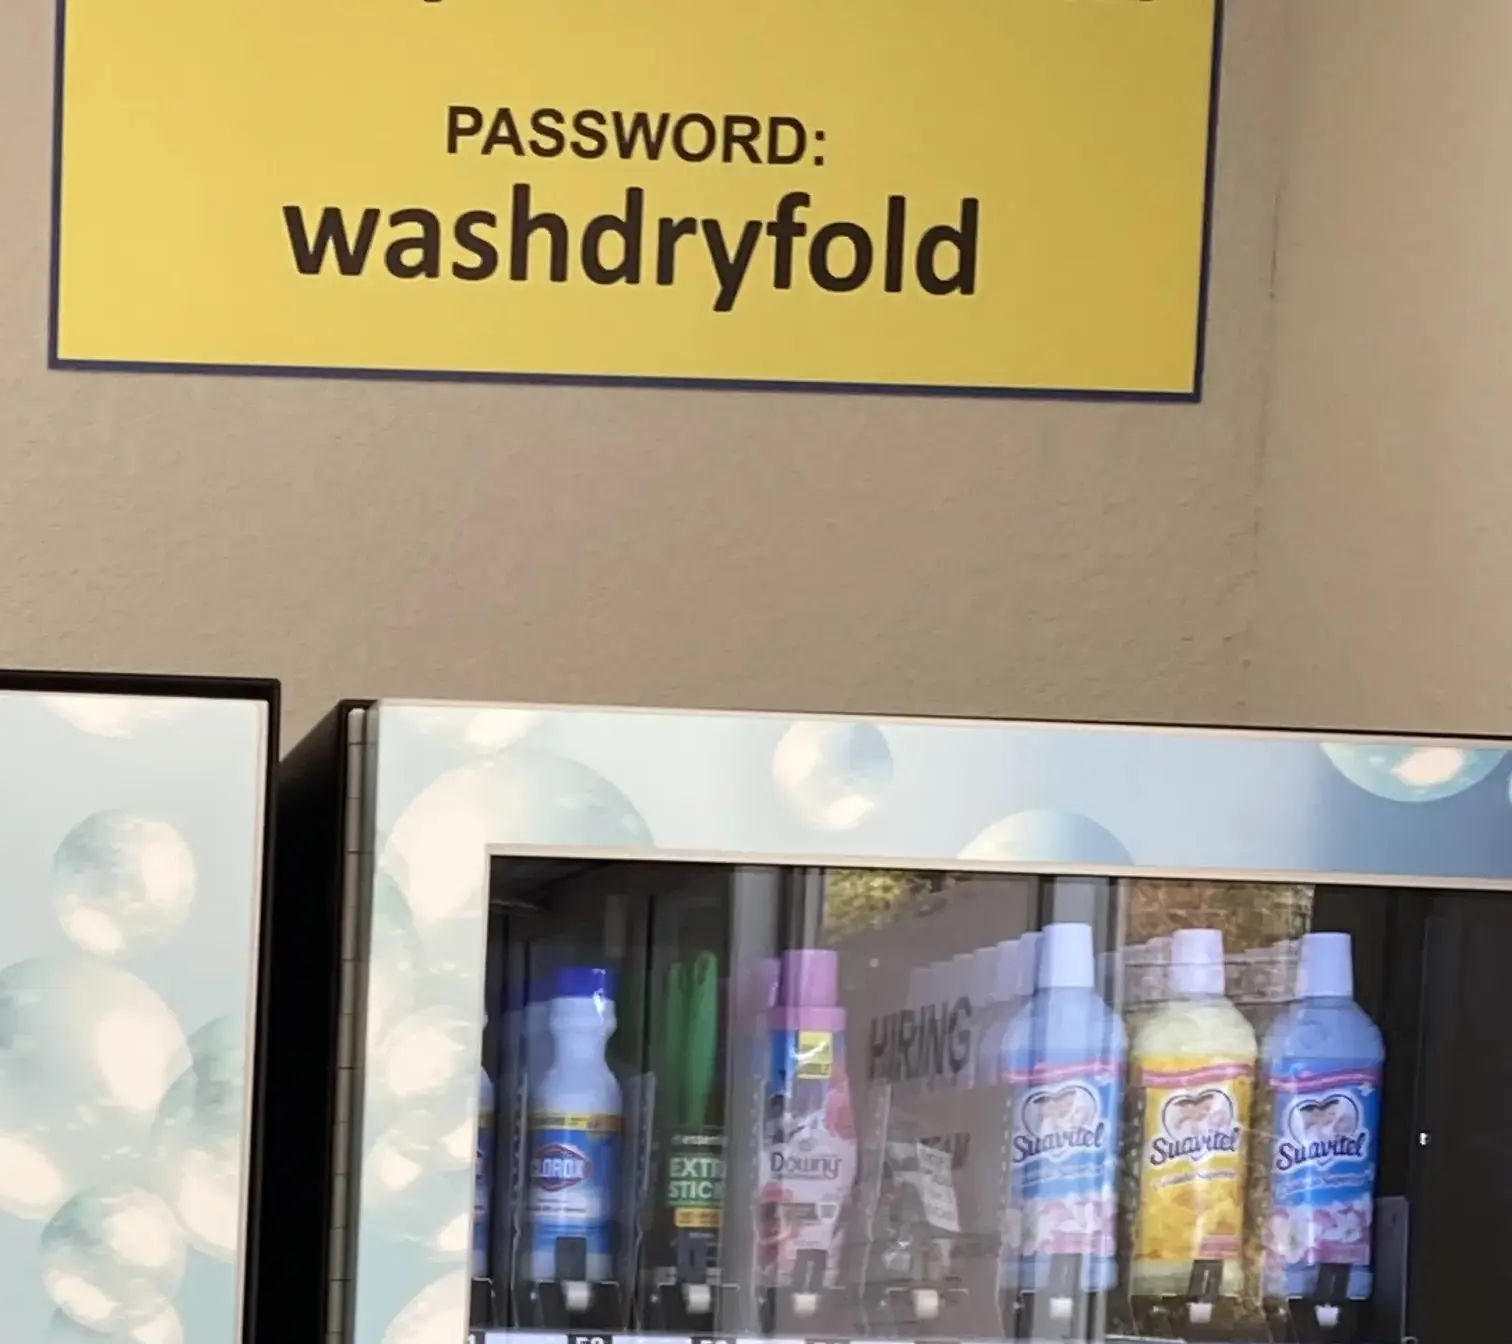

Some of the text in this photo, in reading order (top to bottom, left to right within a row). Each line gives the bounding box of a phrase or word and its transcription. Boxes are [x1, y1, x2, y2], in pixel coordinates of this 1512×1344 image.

[445, 106, 828, 167] PASSWORD:
[282, 184, 980, 313] washdryfold
[1012, 1123, 1104, 1163] Suavitel
[1150, 1129, 1239, 1167] Suavitel
[1276, 1133, 1365, 1171] Suavitel
[771, 1152, 842, 1179] Downy
